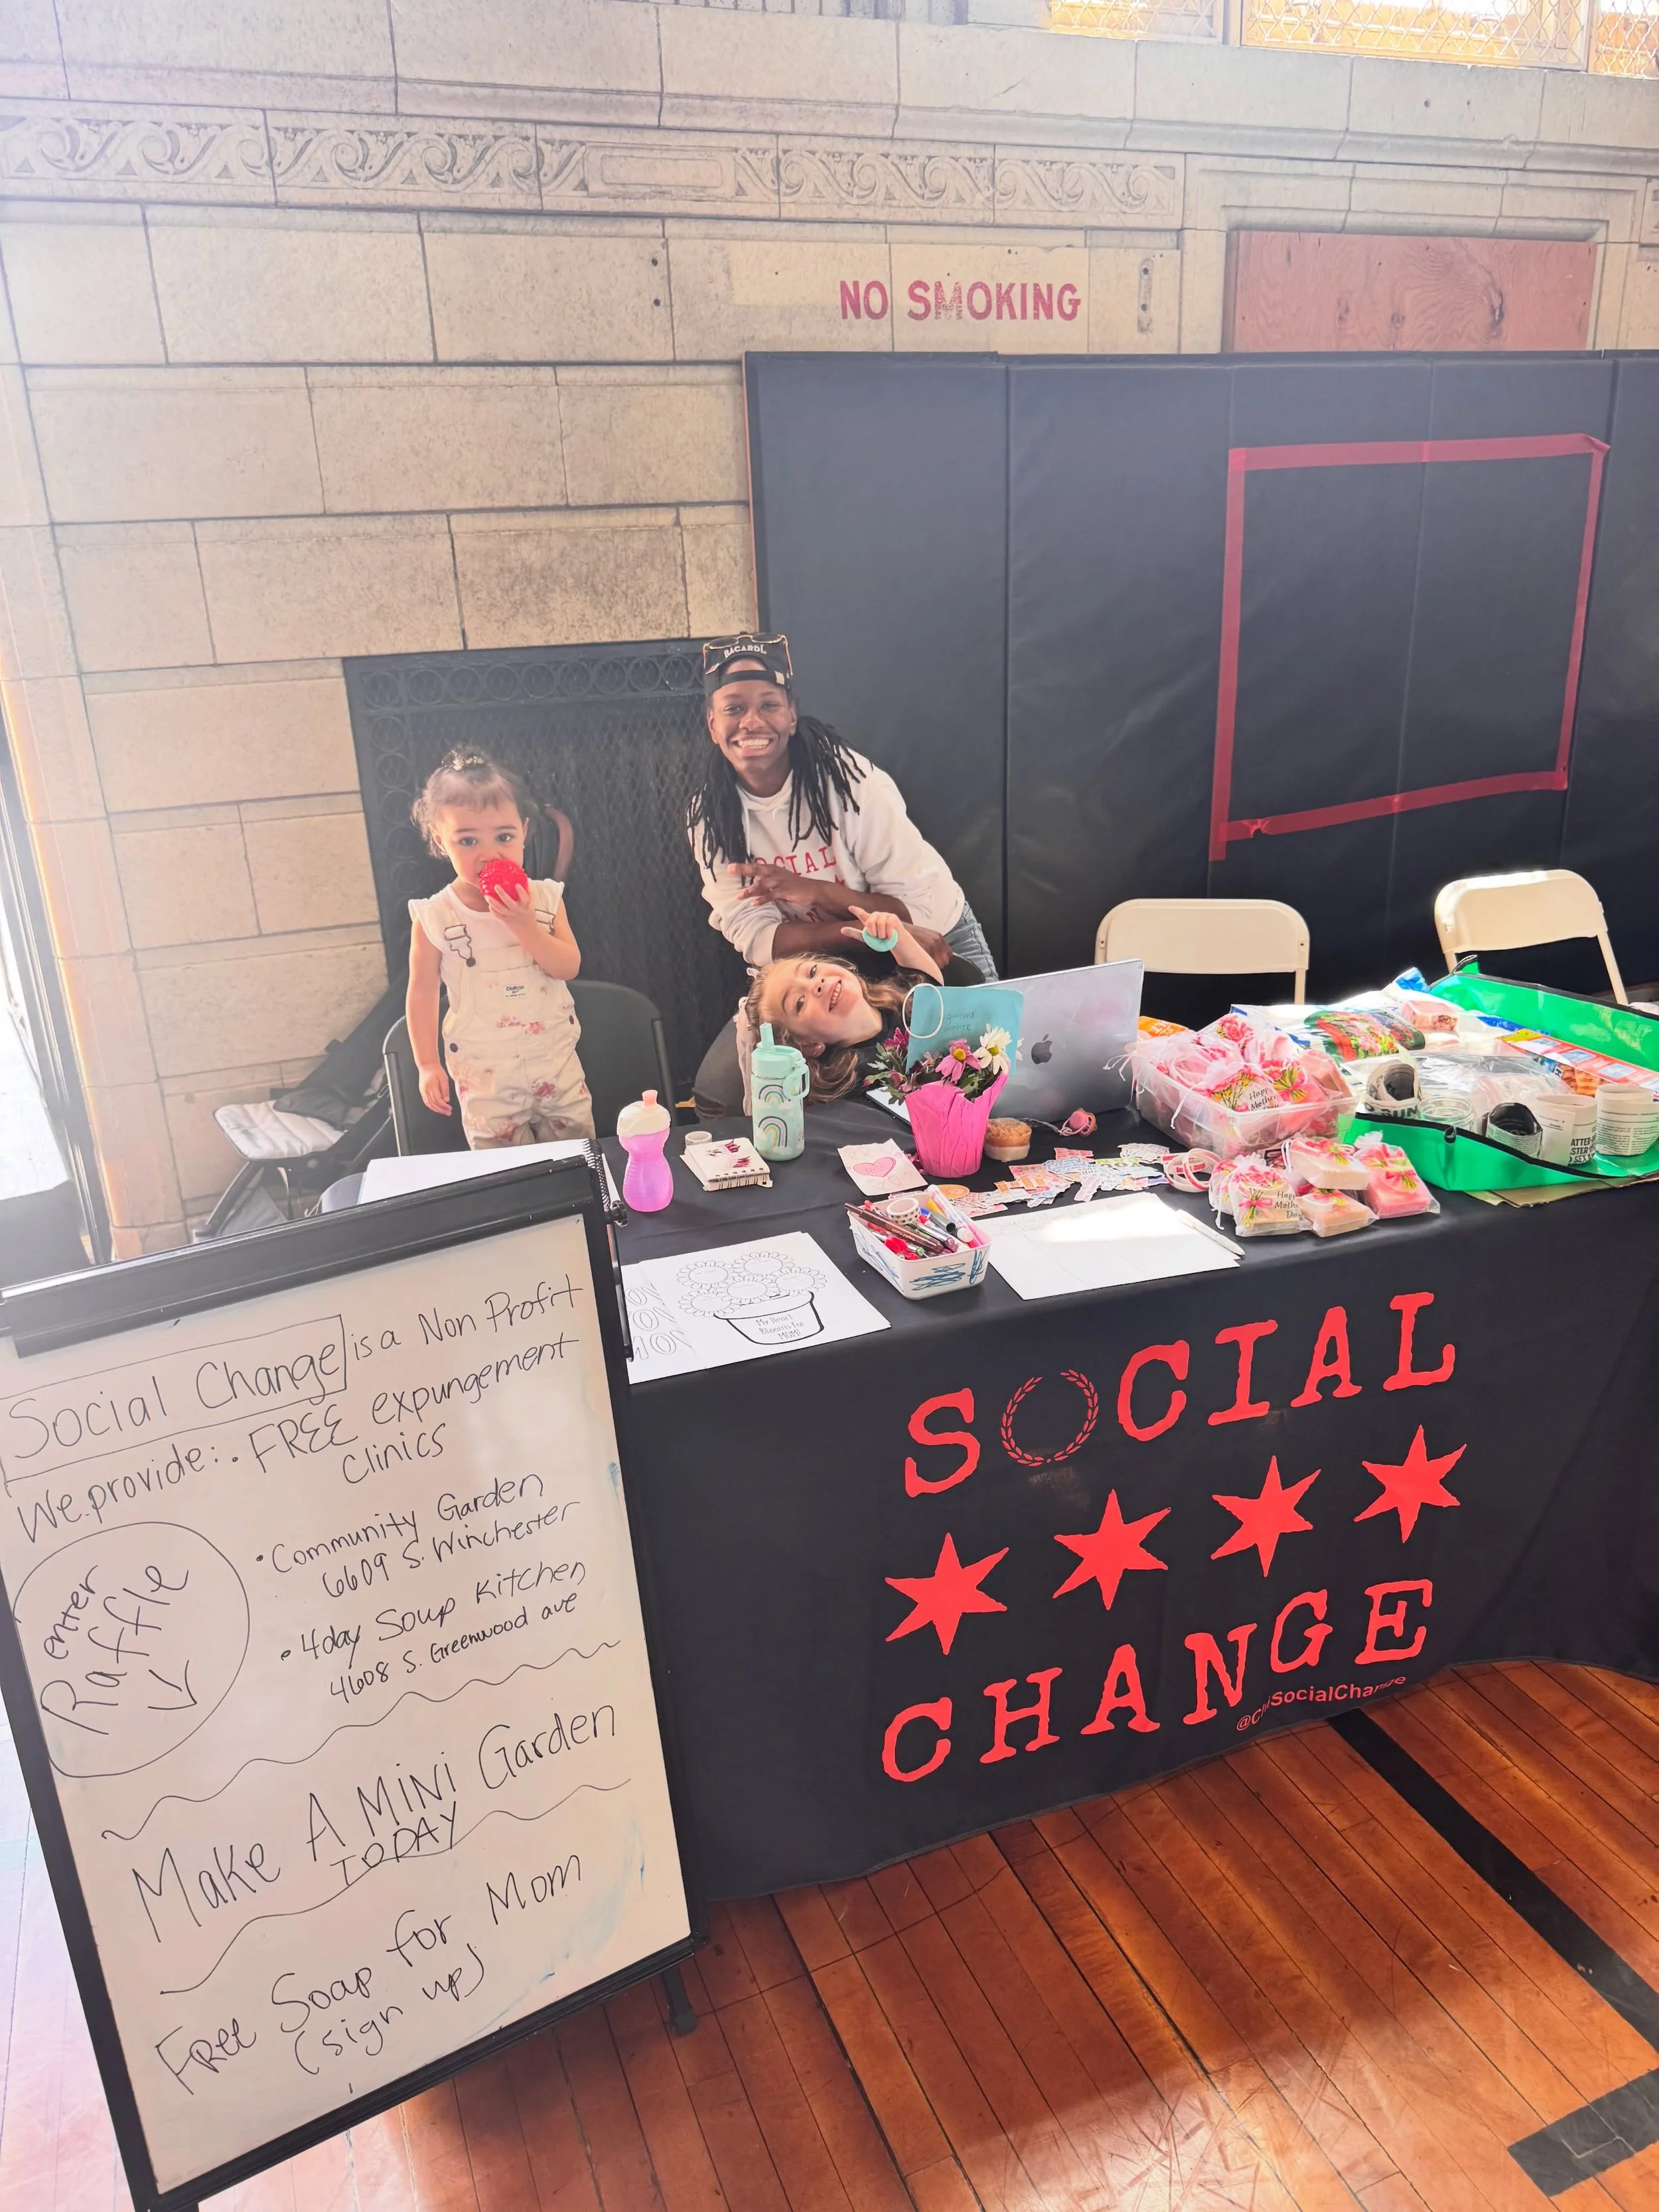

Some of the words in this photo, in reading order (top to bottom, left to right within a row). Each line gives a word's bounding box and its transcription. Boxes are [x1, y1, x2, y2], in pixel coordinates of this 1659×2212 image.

[839, 279, 889, 321] NO
[906, 279, 1082, 321] SMOKING
[9, 1376, 167, 1459] Social
[196, 1343, 340, 1406] Change
[351, 1333, 372, 1361] is
[380, 1330, 401, 1350] a
[418, 1307, 476, 1345] Non
[484, 1274, 583, 1332] Profit
[759, 1323, 792, 1335] Blooms
[770, 1313, 794, 1324] Heart
[249, 1404, 358, 1473] FREE
[372, 1332, 579, 1424] expungement
[904, 1291, 1456, 1498] SOCIAL
[272, 1511, 419, 1573] Community
[437, 1475, 543, 1521] Garden
[323, 1553, 390, 1597] 6609
[433, 1501, 581, 1563] Winchester
[40, 1565, 189, 1735] Raffle
[330, 1661, 389, 1704] 4608
[430, 1606, 529, 1663] Greenwood
[375, 1597, 456, 1641] Soup
[881, 1579, 1433, 1783] CHANGE
[306, 1792, 345, 1862] A
[478, 1705, 615, 1789] Garden
[329, 1800, 457, 1886] TODAY
[271, 1966, 372, 2033] Soap
[386, 1909, 452, 1967] for
[486, 1855, 581, 1925] Mom
